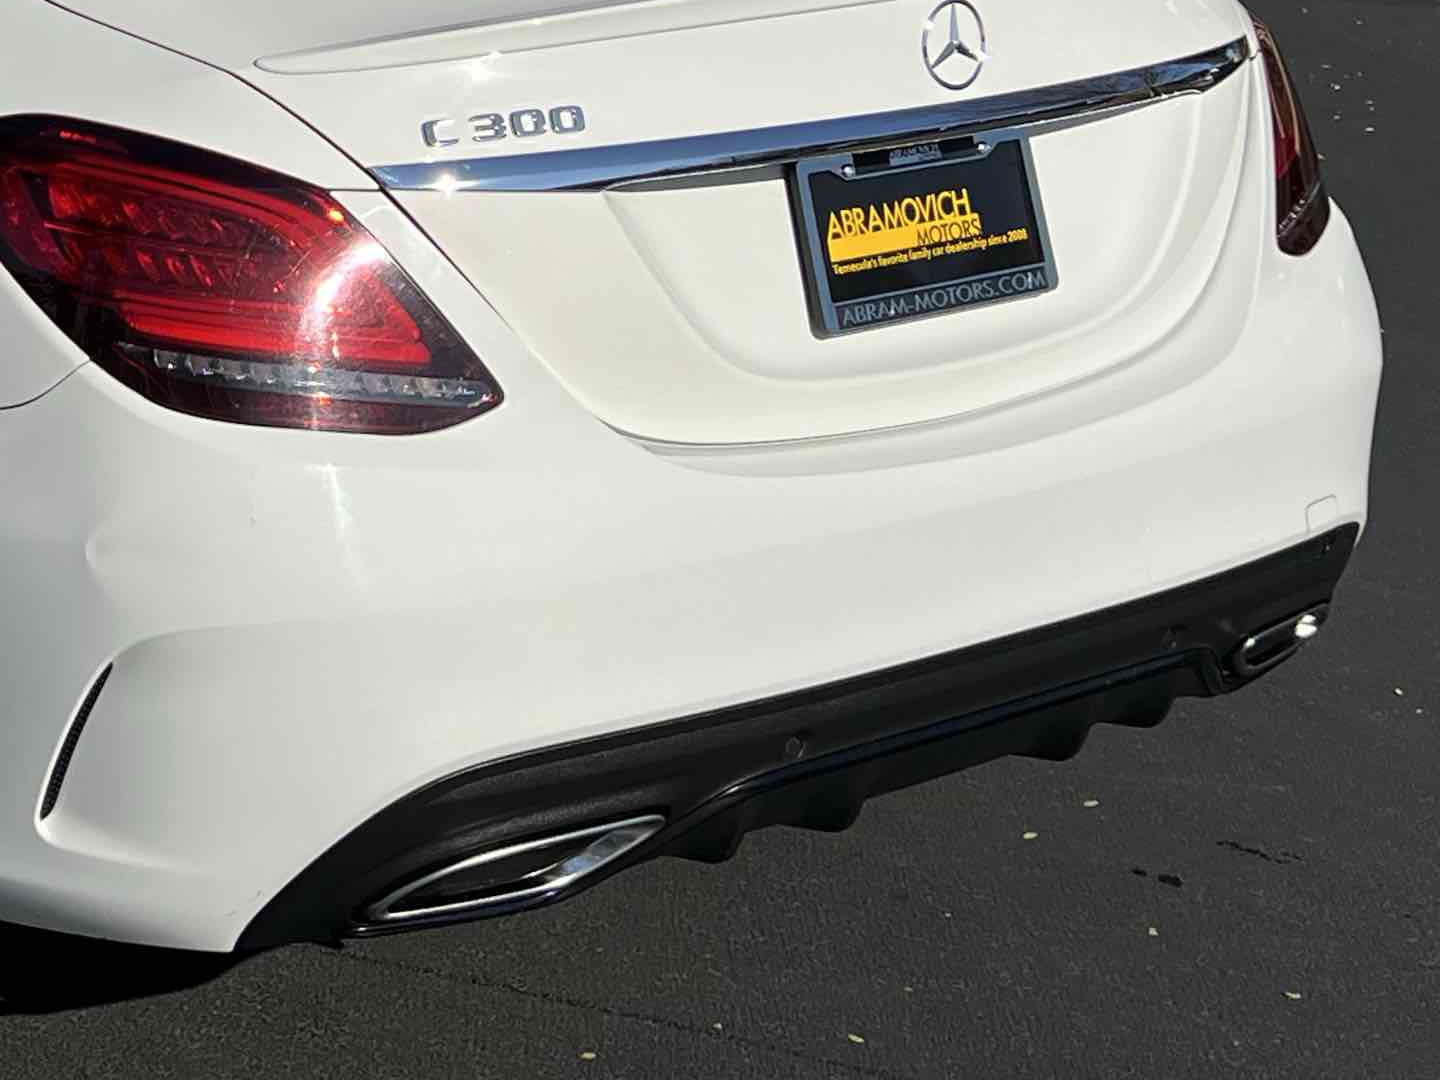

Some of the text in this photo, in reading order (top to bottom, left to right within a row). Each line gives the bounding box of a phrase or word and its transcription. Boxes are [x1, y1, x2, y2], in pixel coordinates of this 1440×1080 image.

[421, 105, 586, 148] C 300
[828, 188, 971, 240] ABRAMOVICH
[916, 217, 982, 246] MOTORS
[932, 246, 945, 257] car
[945, 237, 987, 254] dealership
[987, 233, 1007, 246] since
[842, 272, 1046, 326] ABRAM-MOTORS.COM
